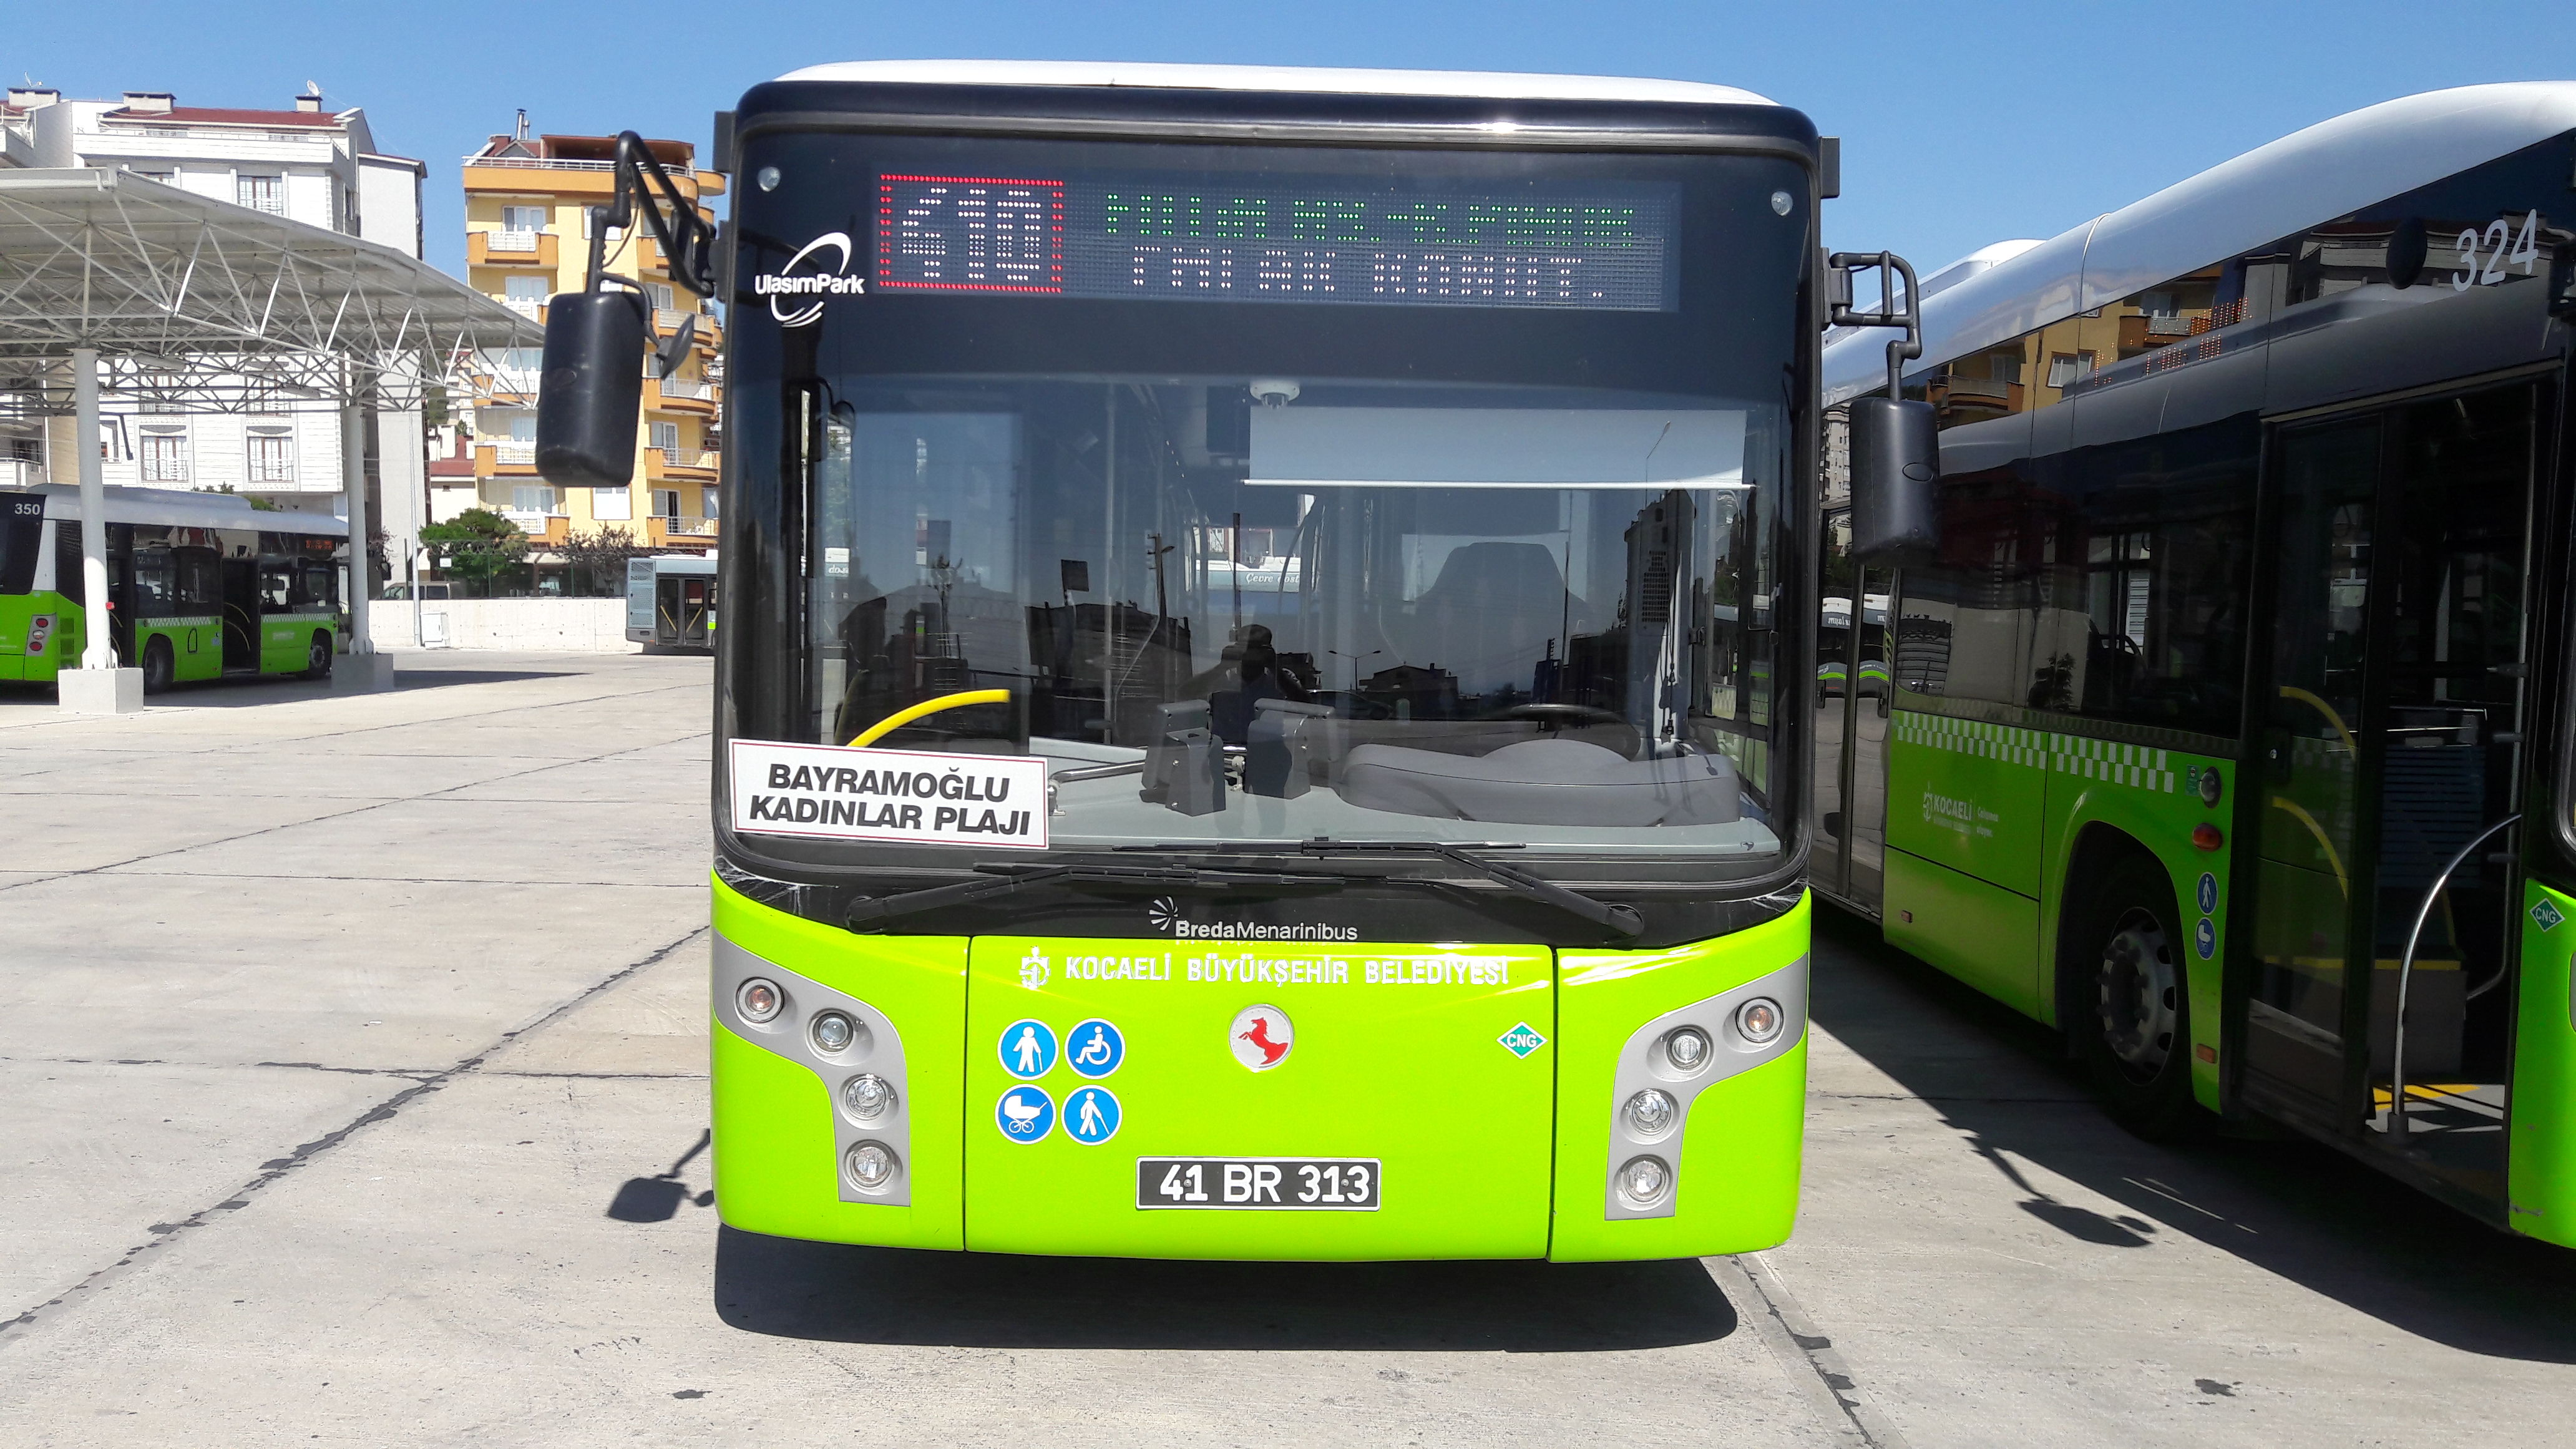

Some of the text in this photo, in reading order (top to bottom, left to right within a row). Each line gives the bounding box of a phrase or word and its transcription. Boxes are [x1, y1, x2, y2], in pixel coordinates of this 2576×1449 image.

[2452, 208, 2539, 292] 324
[14, 503, 41, 515] 350
[767, 764, 1010, 803] BAYRAMOĞLU
[749, 796, 1031, 836] KADINLAR PLAJI
[1175, 920, 1359, 941] BredaMenarinibus
[2535, 907, 2557, 924] CNG
[1066, 953, 1509, 987] KOCAELİ BÜYÜKŞEHİR BELEDİYESİ
[1506, 1033, 1537, 1048] CNG
[1159, 1164, 1370, 1203] 41 BR 313
